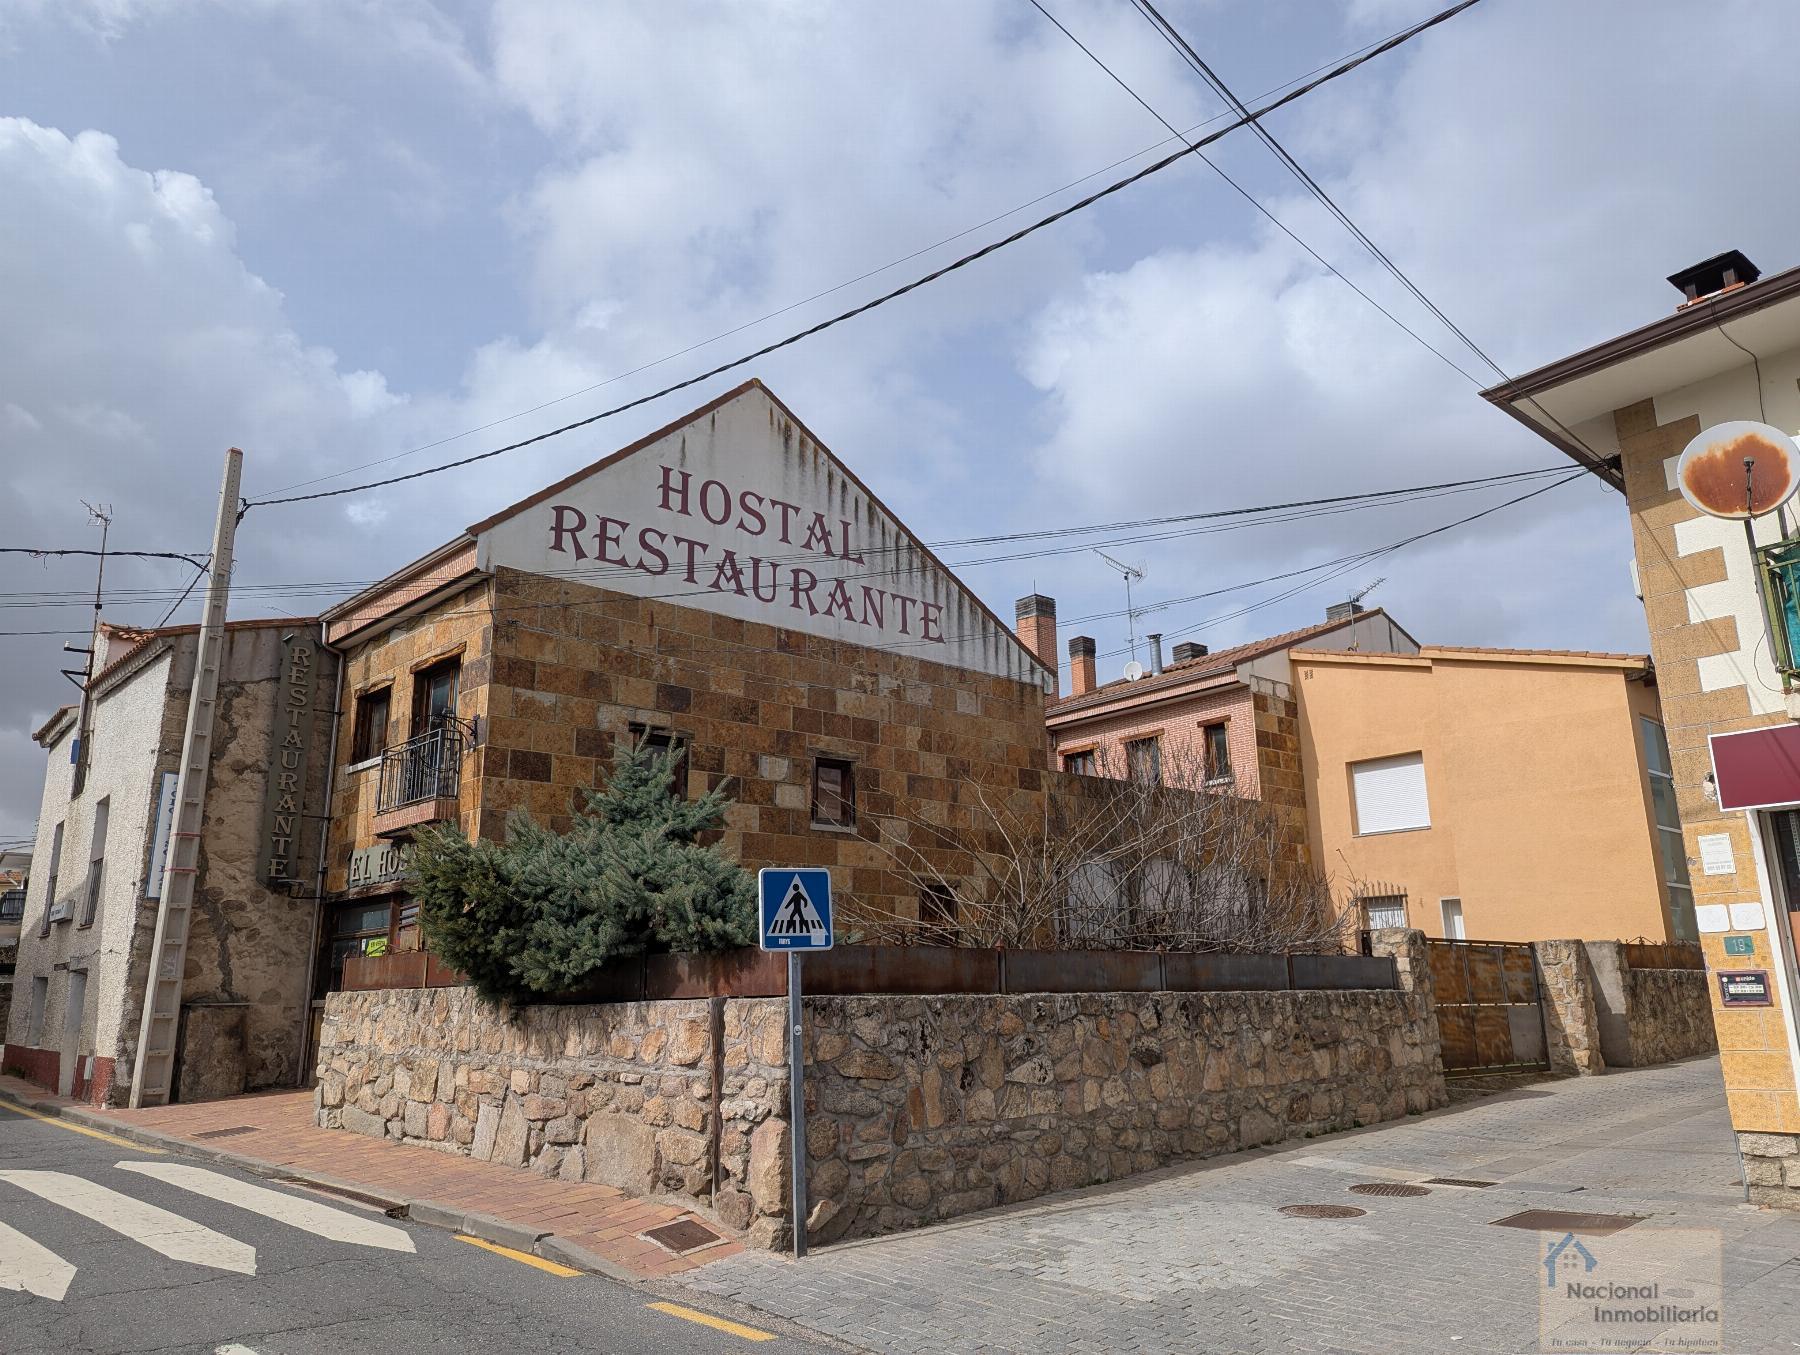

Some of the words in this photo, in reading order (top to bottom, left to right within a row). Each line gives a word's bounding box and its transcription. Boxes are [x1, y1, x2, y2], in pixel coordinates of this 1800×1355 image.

[549, 505, 946, 643] RESTAURANTE
[657, 464, 865, 566] HOSTAL
[268, 646, 311, 878] RESTAURANTE
[351, 854, 371, 881] EL
